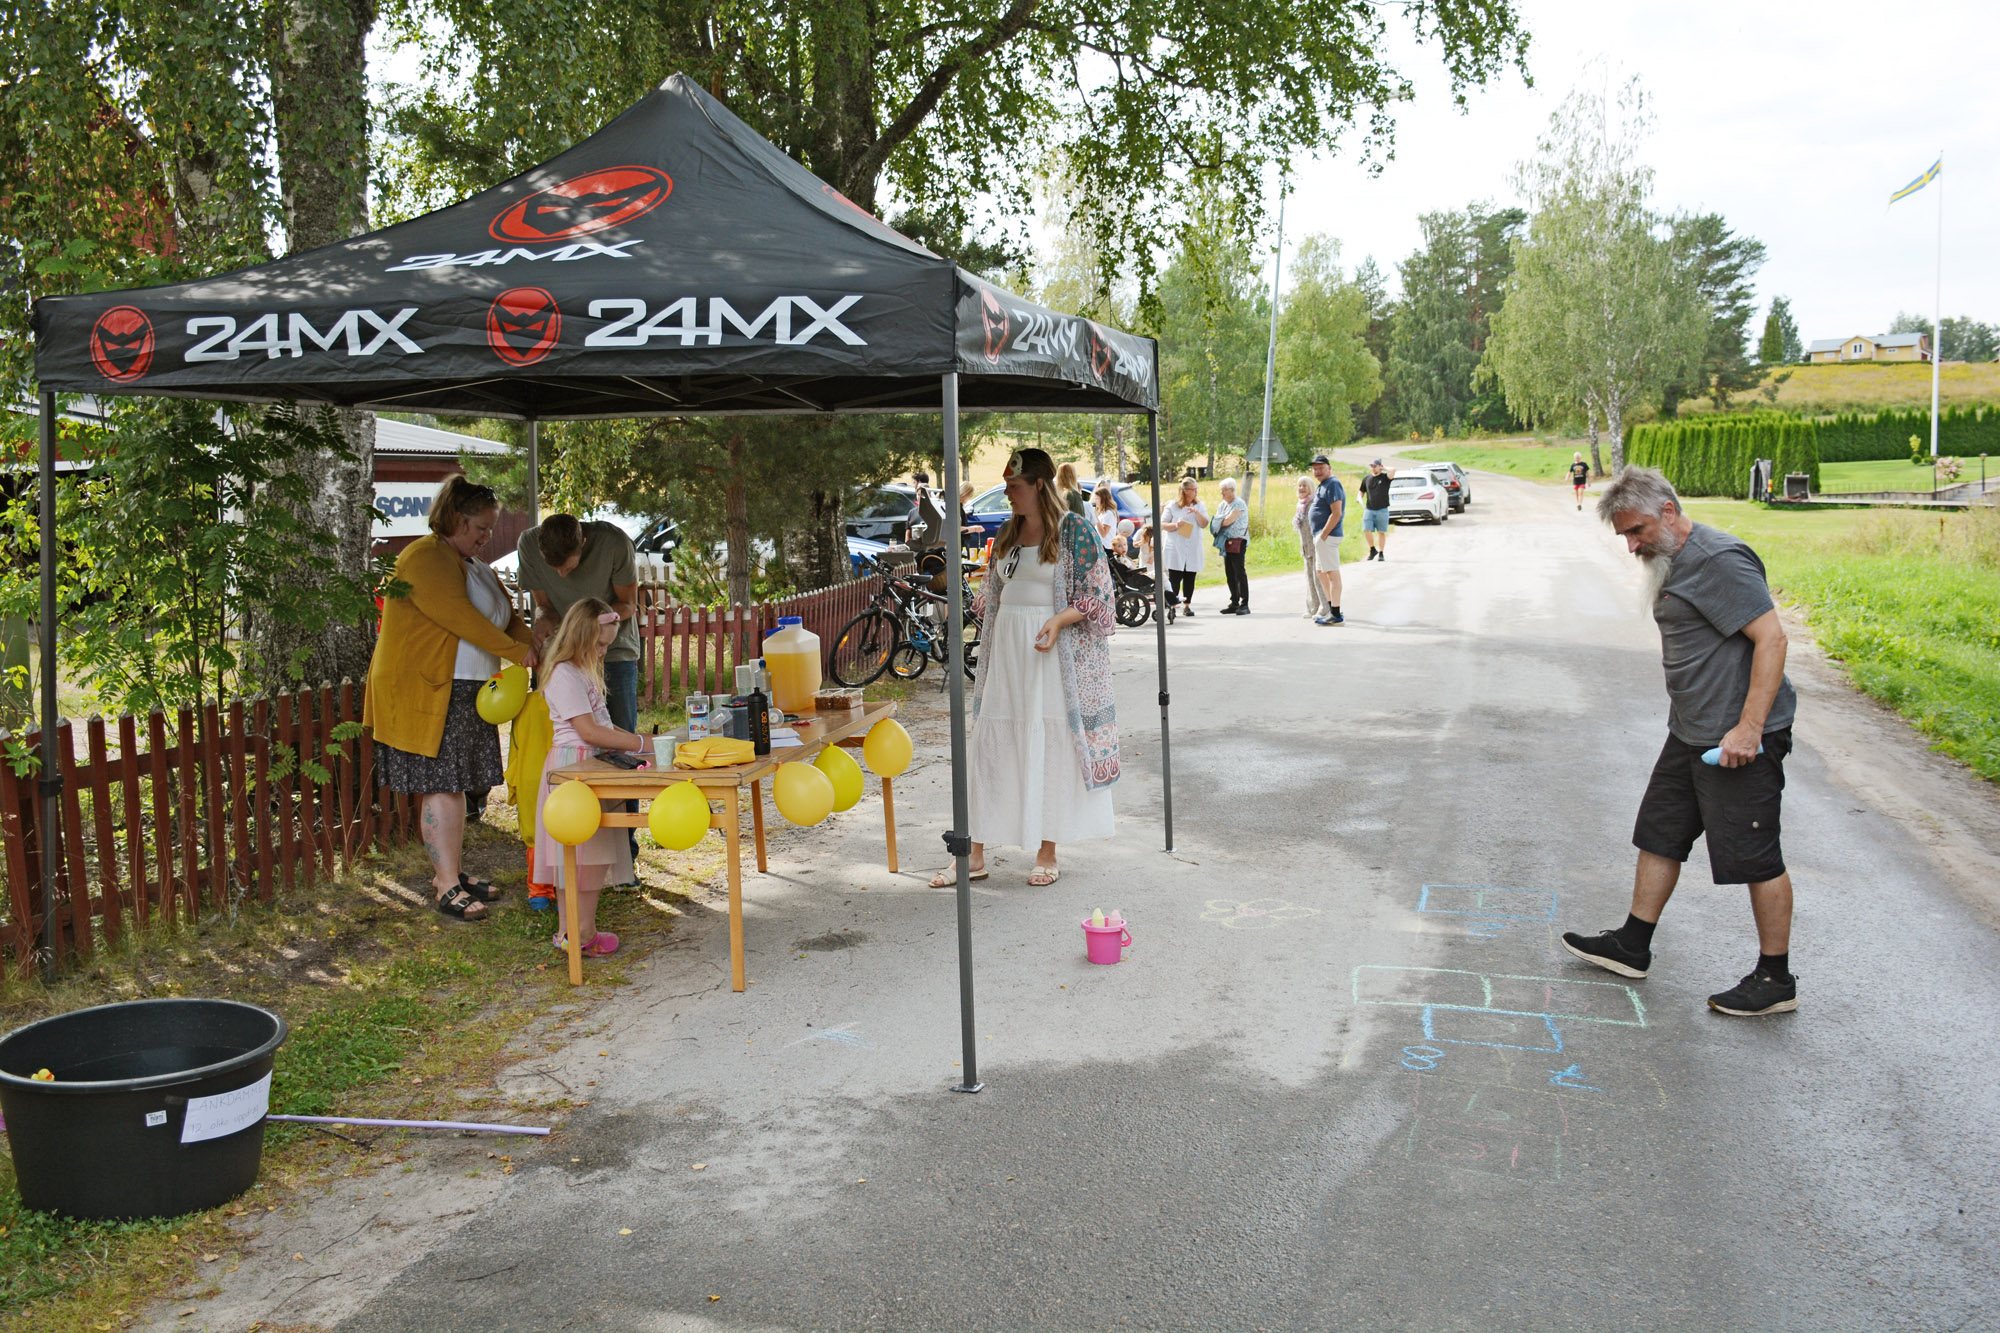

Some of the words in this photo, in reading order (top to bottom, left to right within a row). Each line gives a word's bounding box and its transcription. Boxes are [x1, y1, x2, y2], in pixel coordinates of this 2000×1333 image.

[385, 239, 644, 273] 24MX
[184, 307, 425, 363] 24MX
[585, 295, 868, 346] 24MX
[1012, 309, 1080, 362] 24MX
[376, 496, 435, 517] SCAN
[1401, 1045, 1447, 1071] 8
